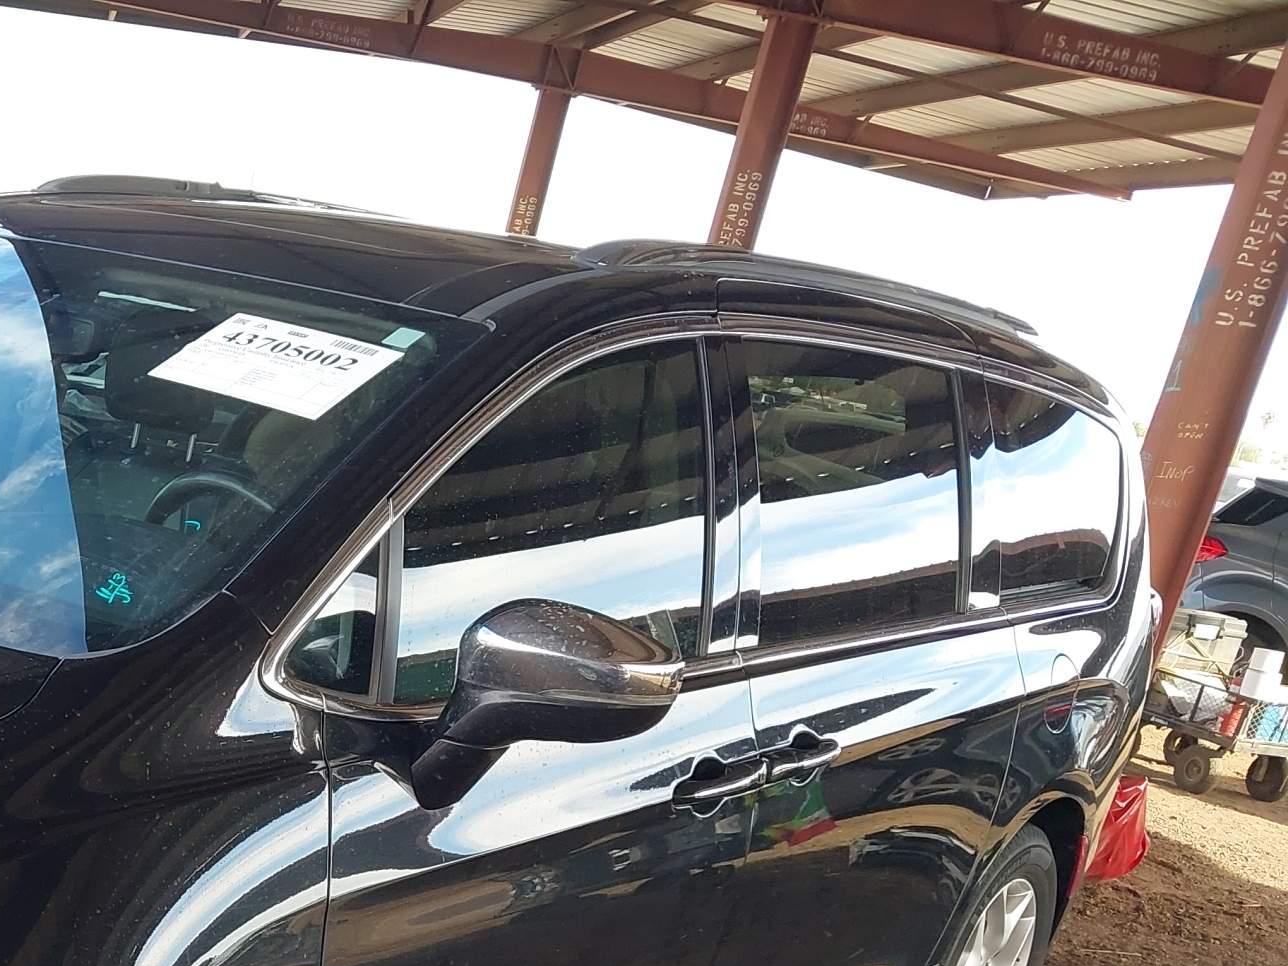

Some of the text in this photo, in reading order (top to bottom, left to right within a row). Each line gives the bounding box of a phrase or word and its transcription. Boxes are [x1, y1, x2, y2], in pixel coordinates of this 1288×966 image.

[1076, 39, 1131, 62] PREFAB
[1135, 48, 1161, 68] INC.
[732, 169, 750, 196] INC.
[1215, 170, 1288, 327] U.S. PREFAB
[222, 331, 359, 371] 43705002
